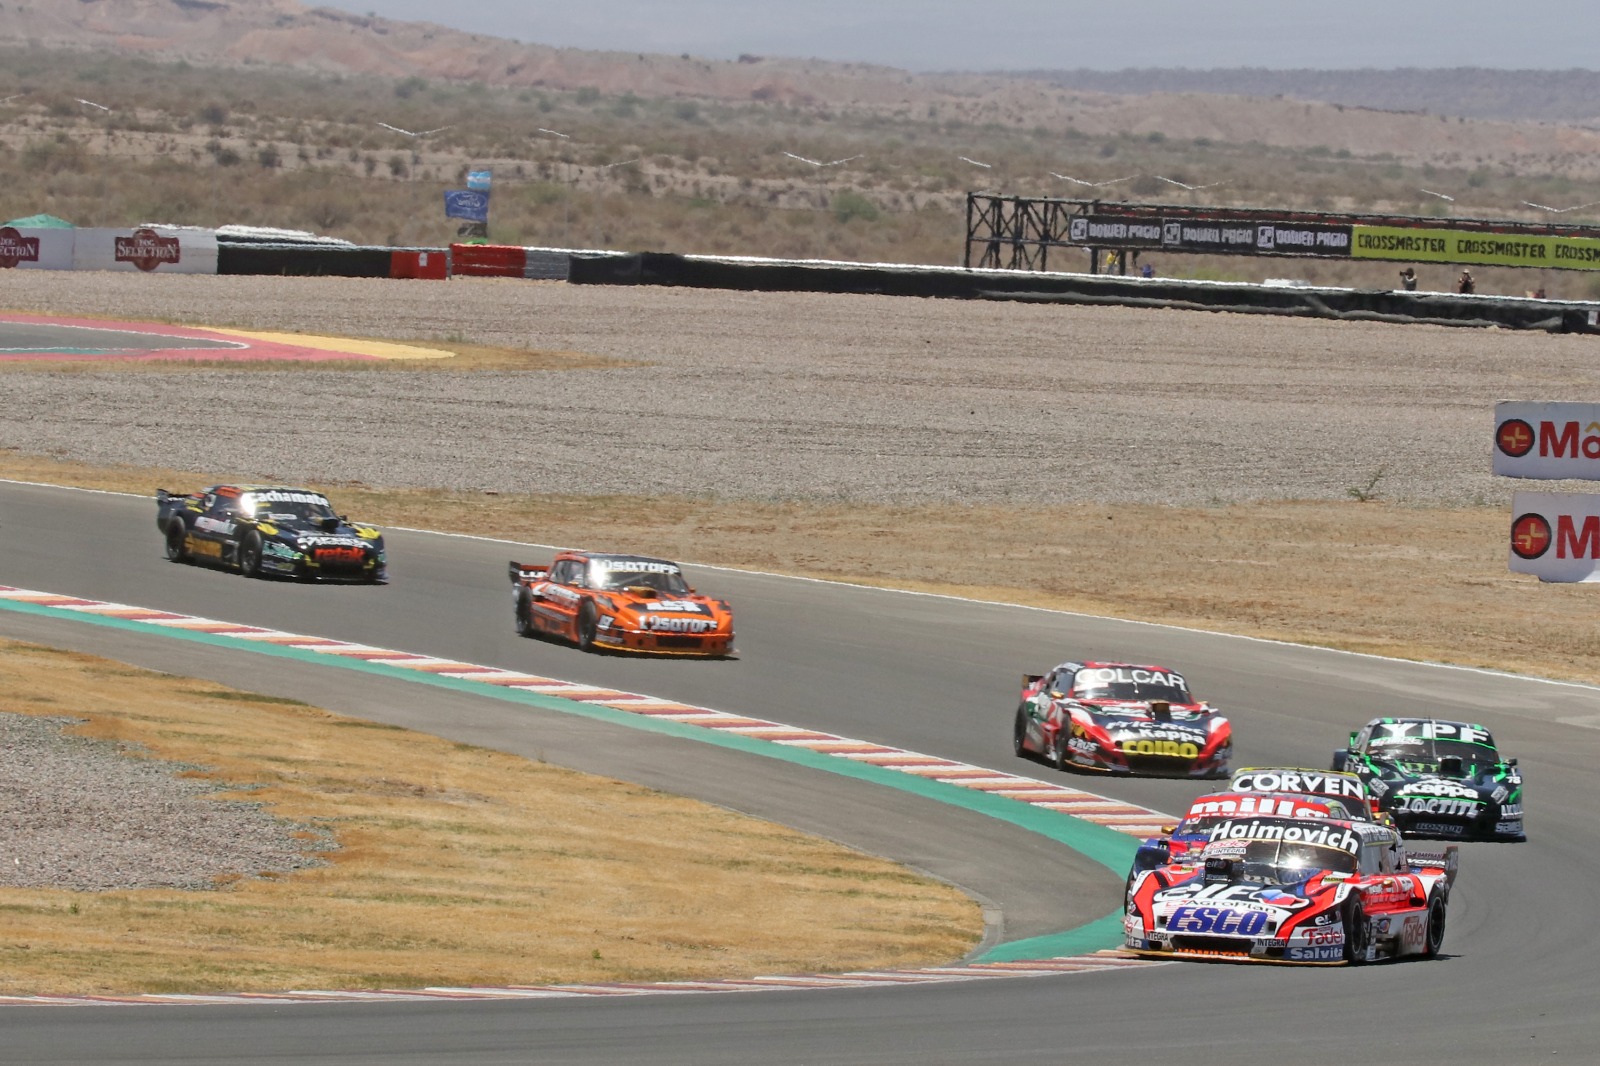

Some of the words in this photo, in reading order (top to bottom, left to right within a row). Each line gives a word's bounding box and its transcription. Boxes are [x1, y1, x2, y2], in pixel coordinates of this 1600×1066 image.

[117, 241, 177, 258] SELECTION
[1358, 233, 1446, 253] CROSSMASTER
[1457, 239, 1546, 259] CROSSMASTER
[1074, 668, 1188, 692] GOLCAR
[1138, 729, 1206, 745] Kappa
[1380, 723, 1489, 742] YPF
[1232, 774, 1364, 800] CORVEN
[1209, 820, 1359, 855] Haimovich
[1166, 907, 1268, 935] ESCO
[1257, 938, 1286, 947] INTEGRA
